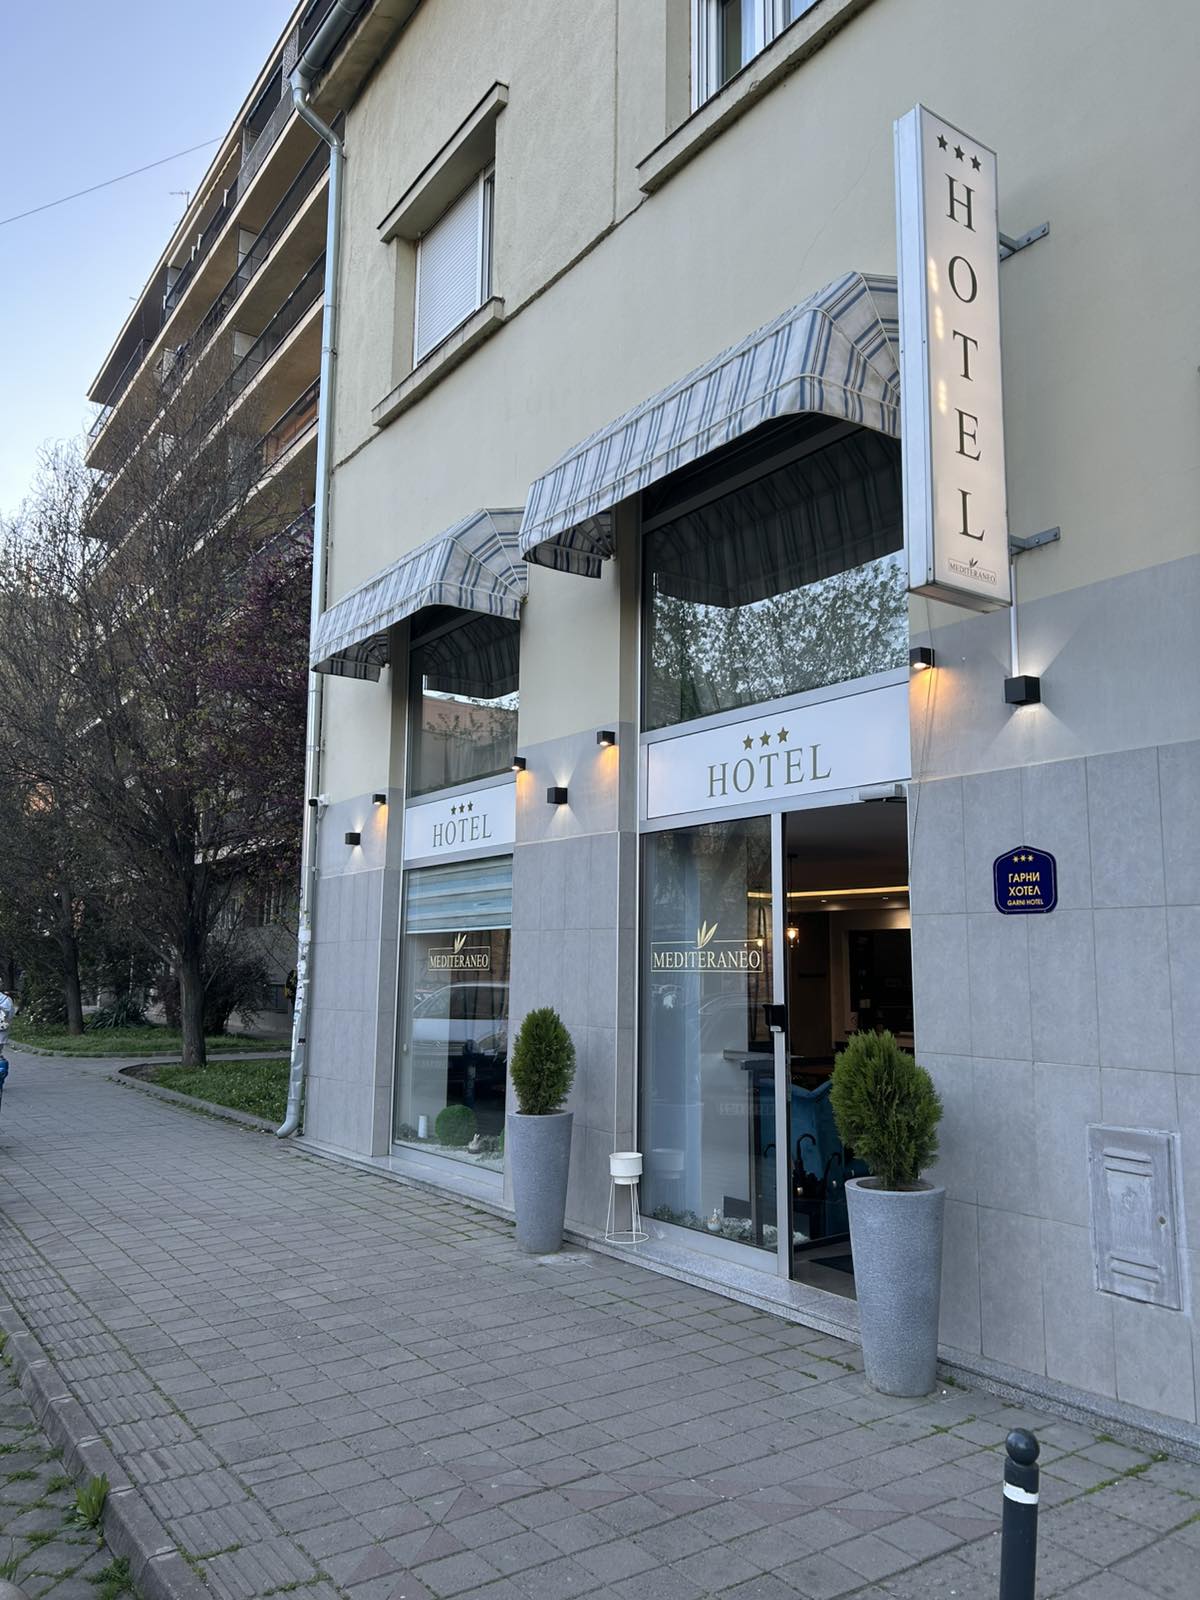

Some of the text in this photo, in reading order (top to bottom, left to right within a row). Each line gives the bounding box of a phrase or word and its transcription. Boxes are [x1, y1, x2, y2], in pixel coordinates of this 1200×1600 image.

[945, 173, 985, 542] HOTEL
[949, 562, 996, 582] MEDITERANEO
[707, 743, 832, 798] HOTEL
[432, 813, 492, 848] HOTEL
[1008, 871, 1040, 883] ГАРНИ
[1008, 885, 1041, 896] ХОТЕЛ
[429, 953, 489, 968] MEDITERANEO
[653, 950, 761, 968] MEDITERANEO
